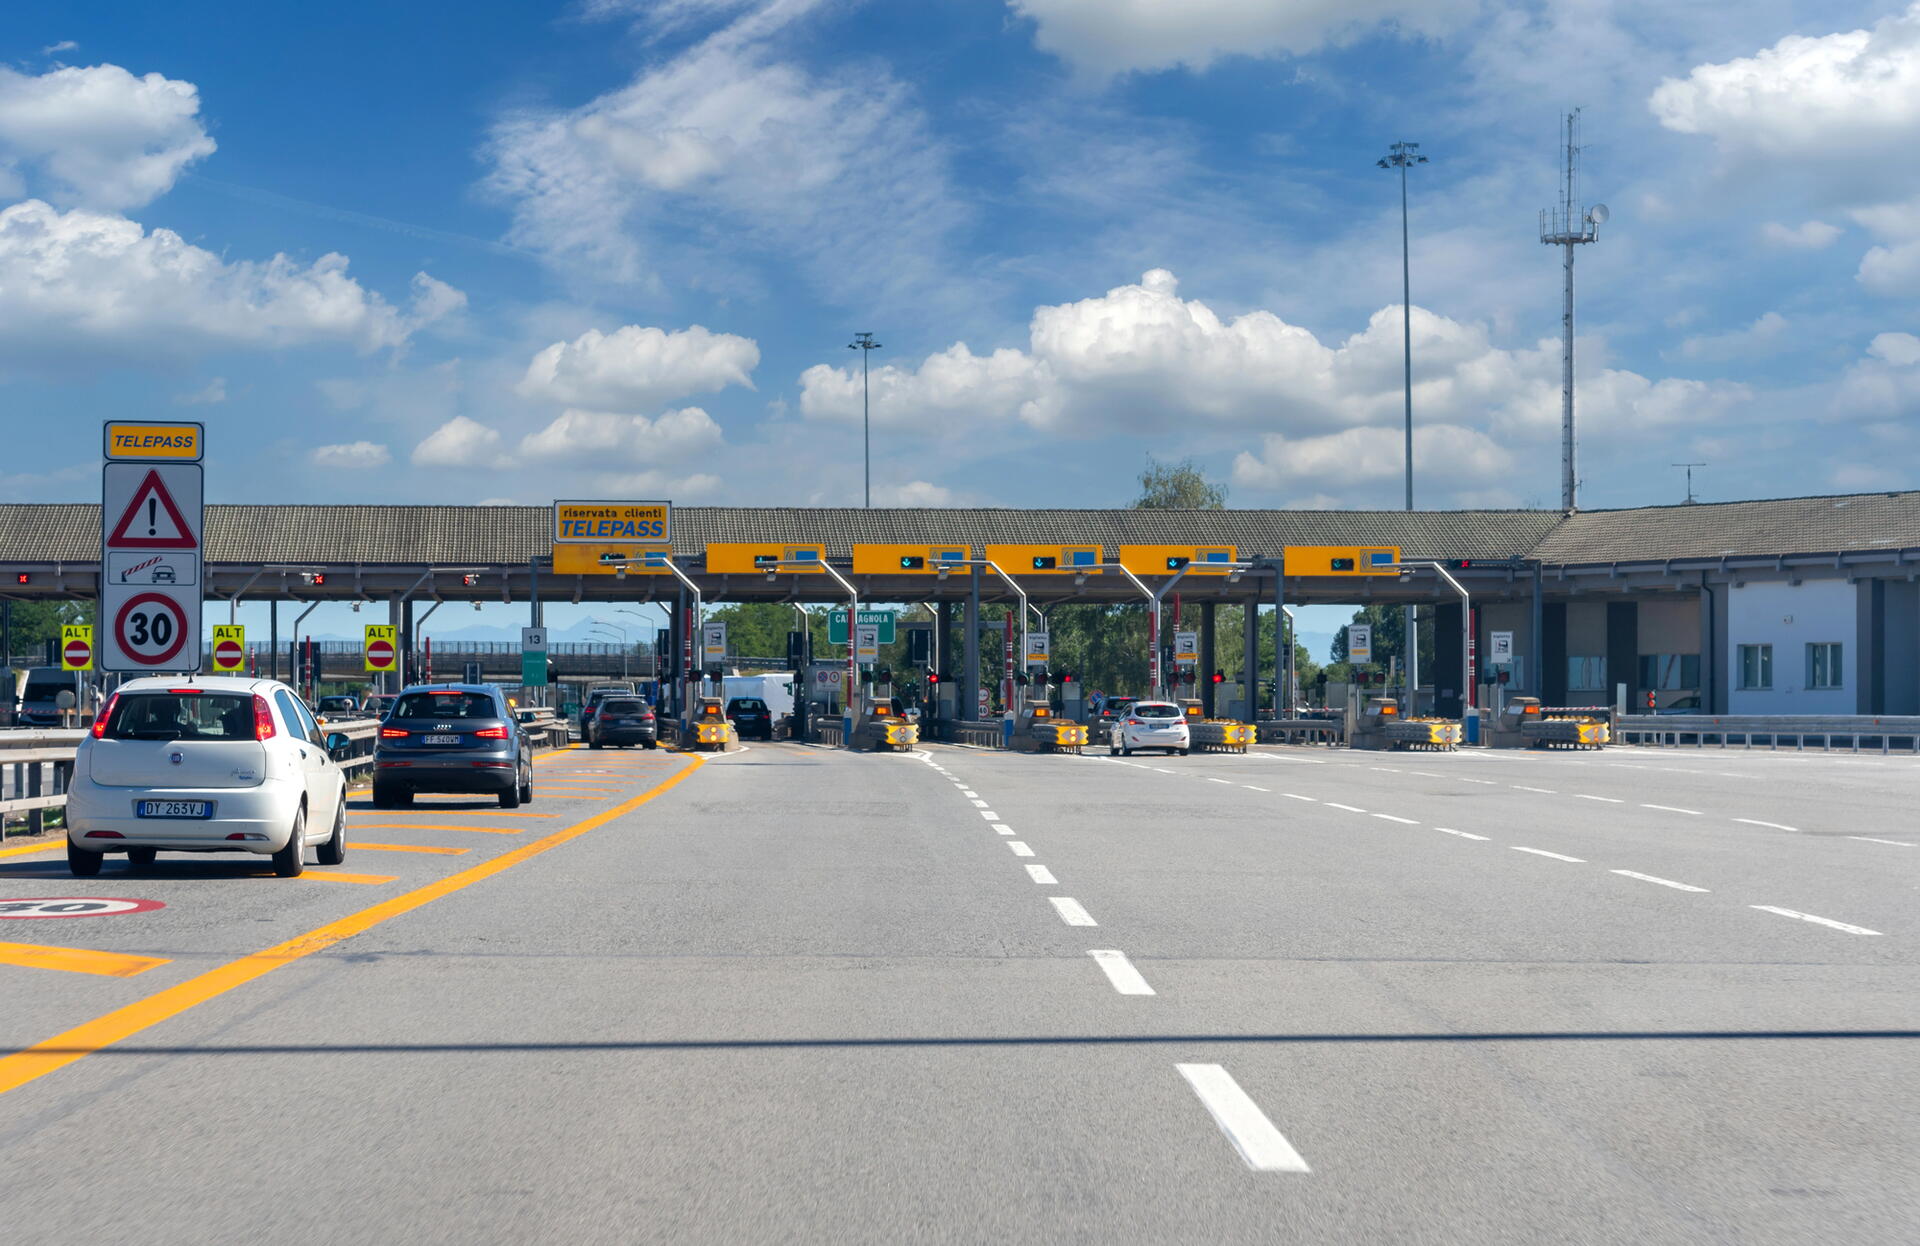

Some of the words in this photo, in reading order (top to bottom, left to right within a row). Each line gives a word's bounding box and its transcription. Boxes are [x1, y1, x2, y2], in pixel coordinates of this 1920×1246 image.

[115, 435, 193, 448] TELEPASS
[563, 508, 617, 518] riservata
[624, 508, 662, 518] clienti
[562, 520, 664, 537] TELEPASS
[835, 614, 889, 624] CAAGNOLA
[65, 627, 90, 638] ALT
[130, 612, 172, 646] 30
[216, 627, 242, 638] ALT
[368, 627, 394, 638] ALT
[529, 634, 541, 645] 13
[146, 802, 161, 815] DY
[166, 802, 205, 815] 263VJ
